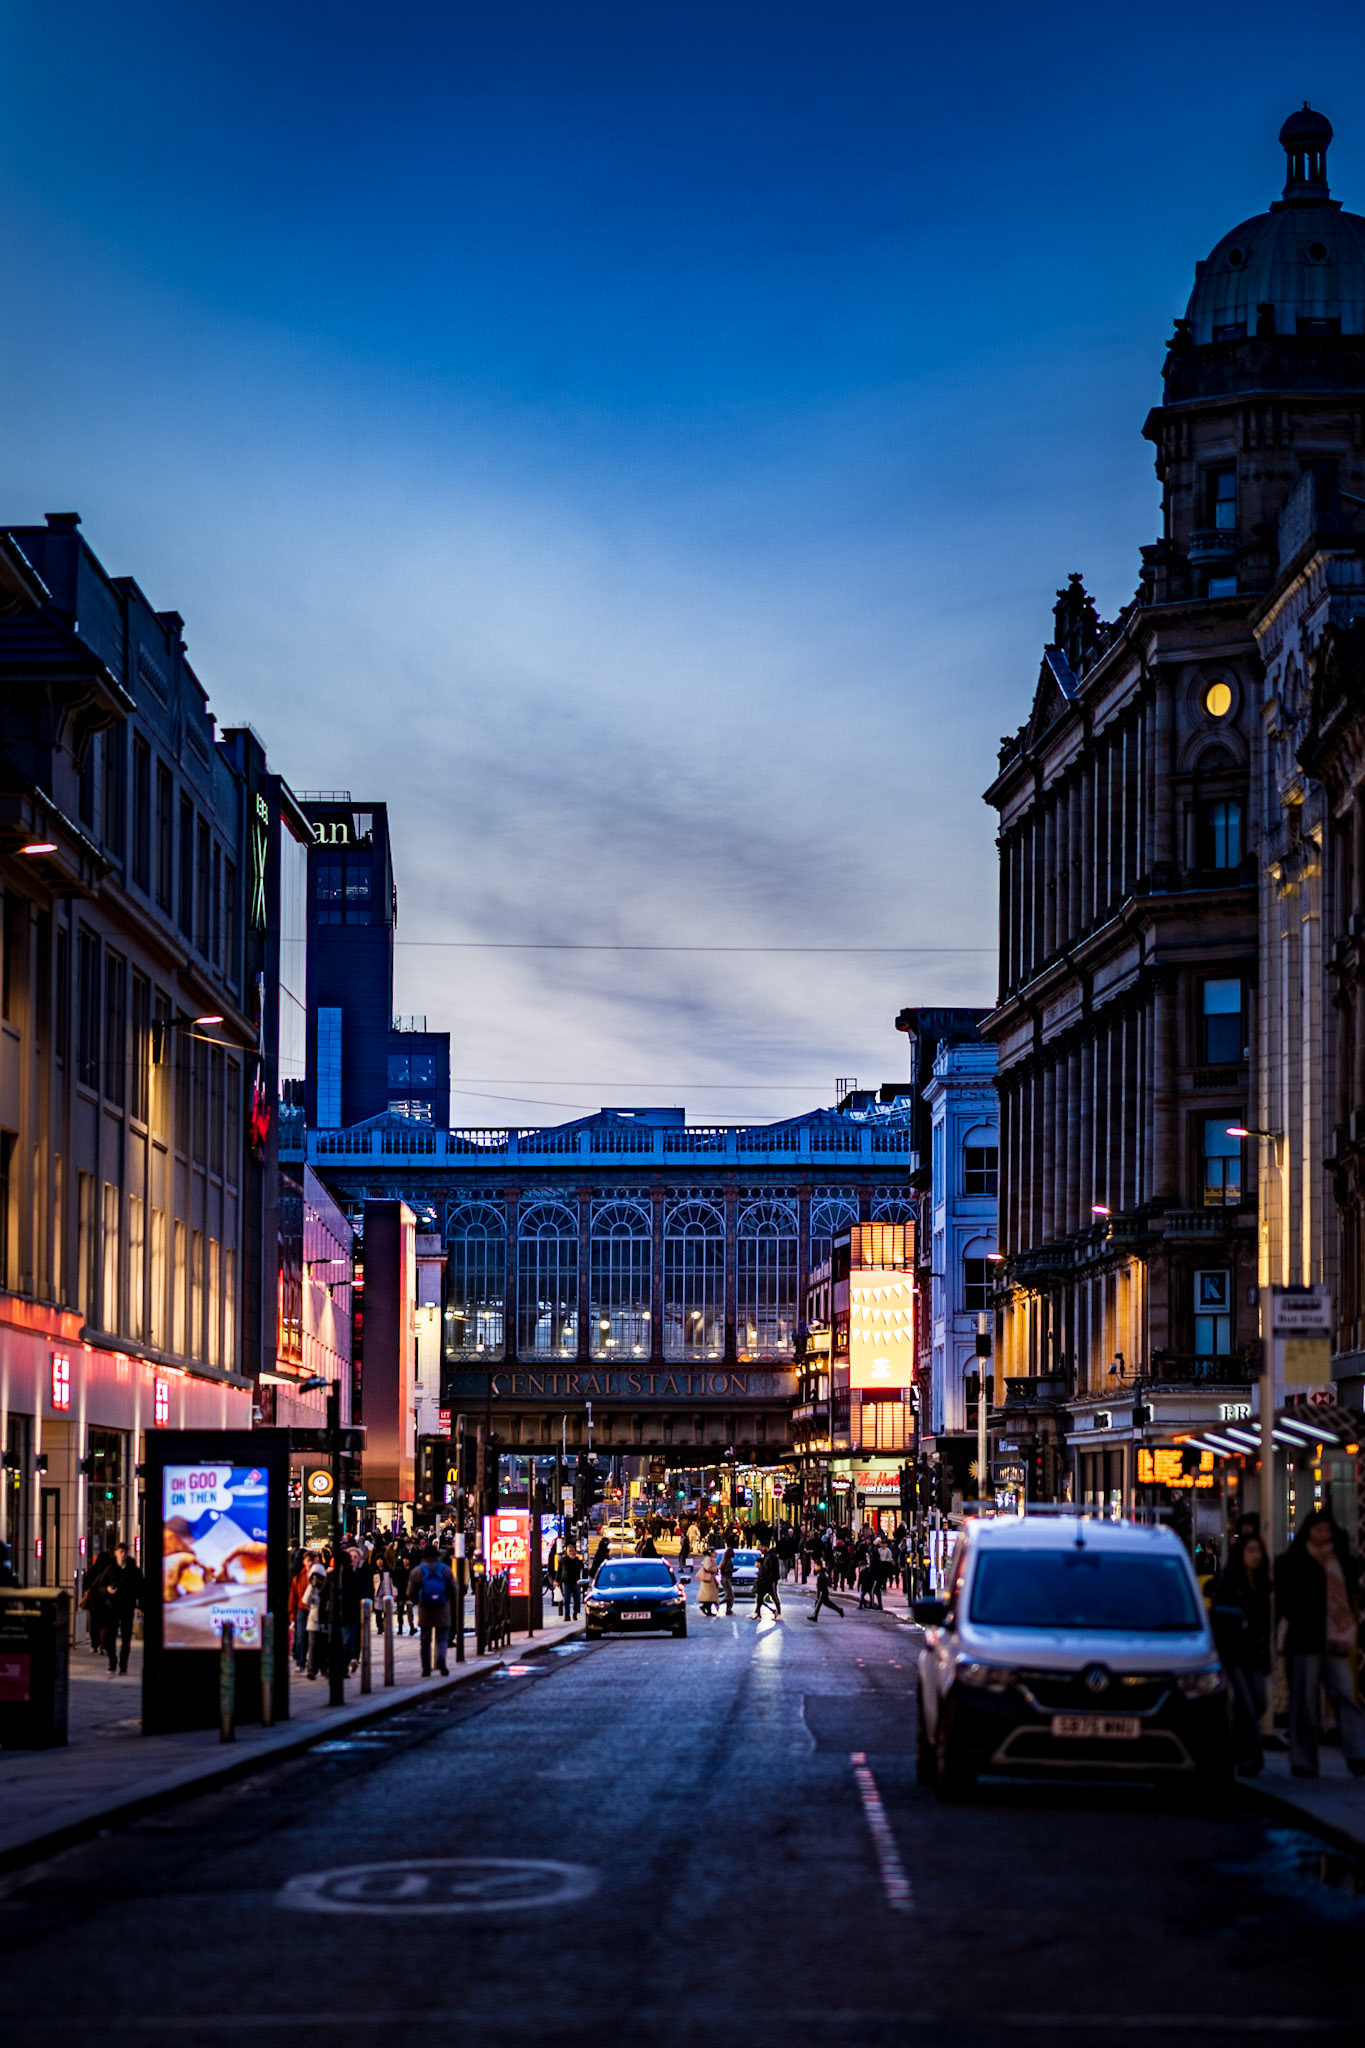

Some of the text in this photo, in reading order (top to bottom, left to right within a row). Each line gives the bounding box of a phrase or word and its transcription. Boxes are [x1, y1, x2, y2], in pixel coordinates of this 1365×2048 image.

[491, 1373, 749, 1395] CENTRAL STATION
[440, 1411, 451, 1419] LET
[171, 1472, 217, 1491] OH GOO
[171, 1491, 217, 1506] ON THEN
[307, 1495, 334, 1506] Subway
[491, 1551, 527, 1561] MILLION
[211, 1605, 256, 1616] Domino's
